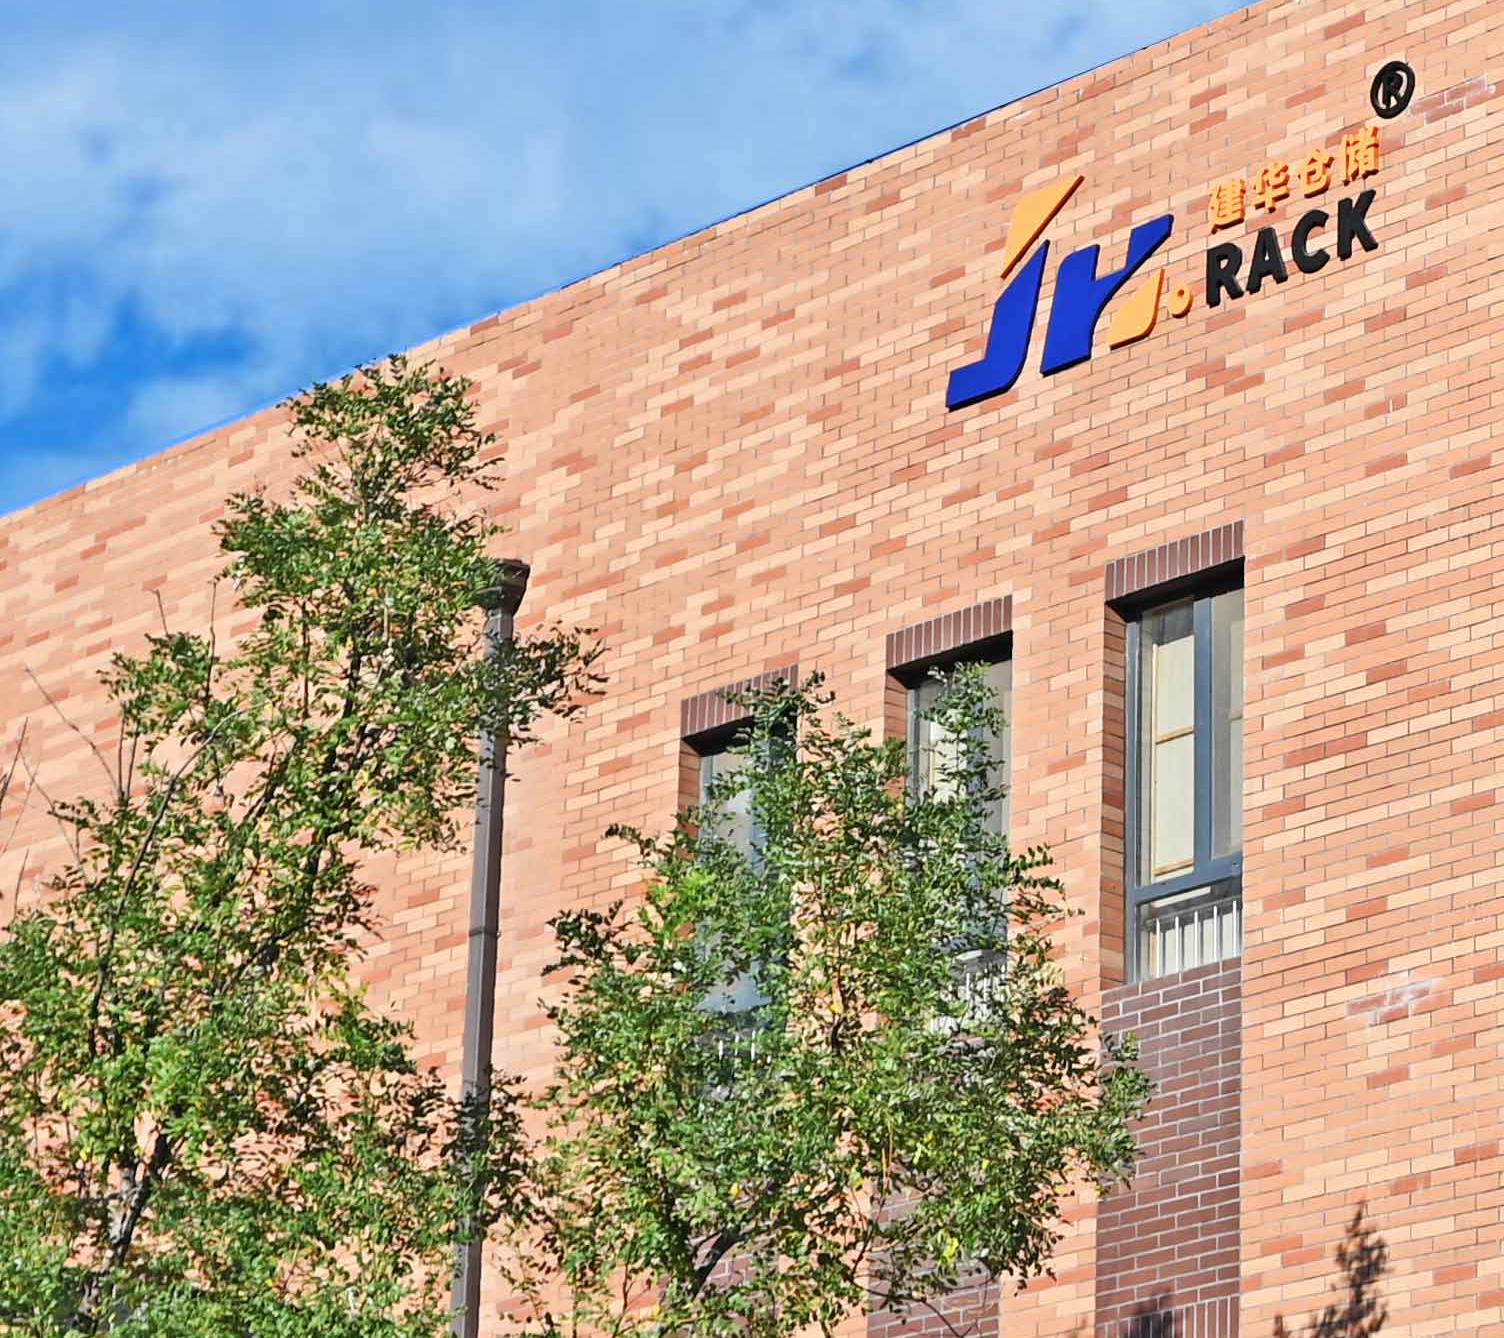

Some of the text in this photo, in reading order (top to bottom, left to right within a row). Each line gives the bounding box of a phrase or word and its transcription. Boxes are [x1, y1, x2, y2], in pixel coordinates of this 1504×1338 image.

[1208, 125, 1381, 234] 建华仓储
[1205, 189, 1379, 309] RACK
